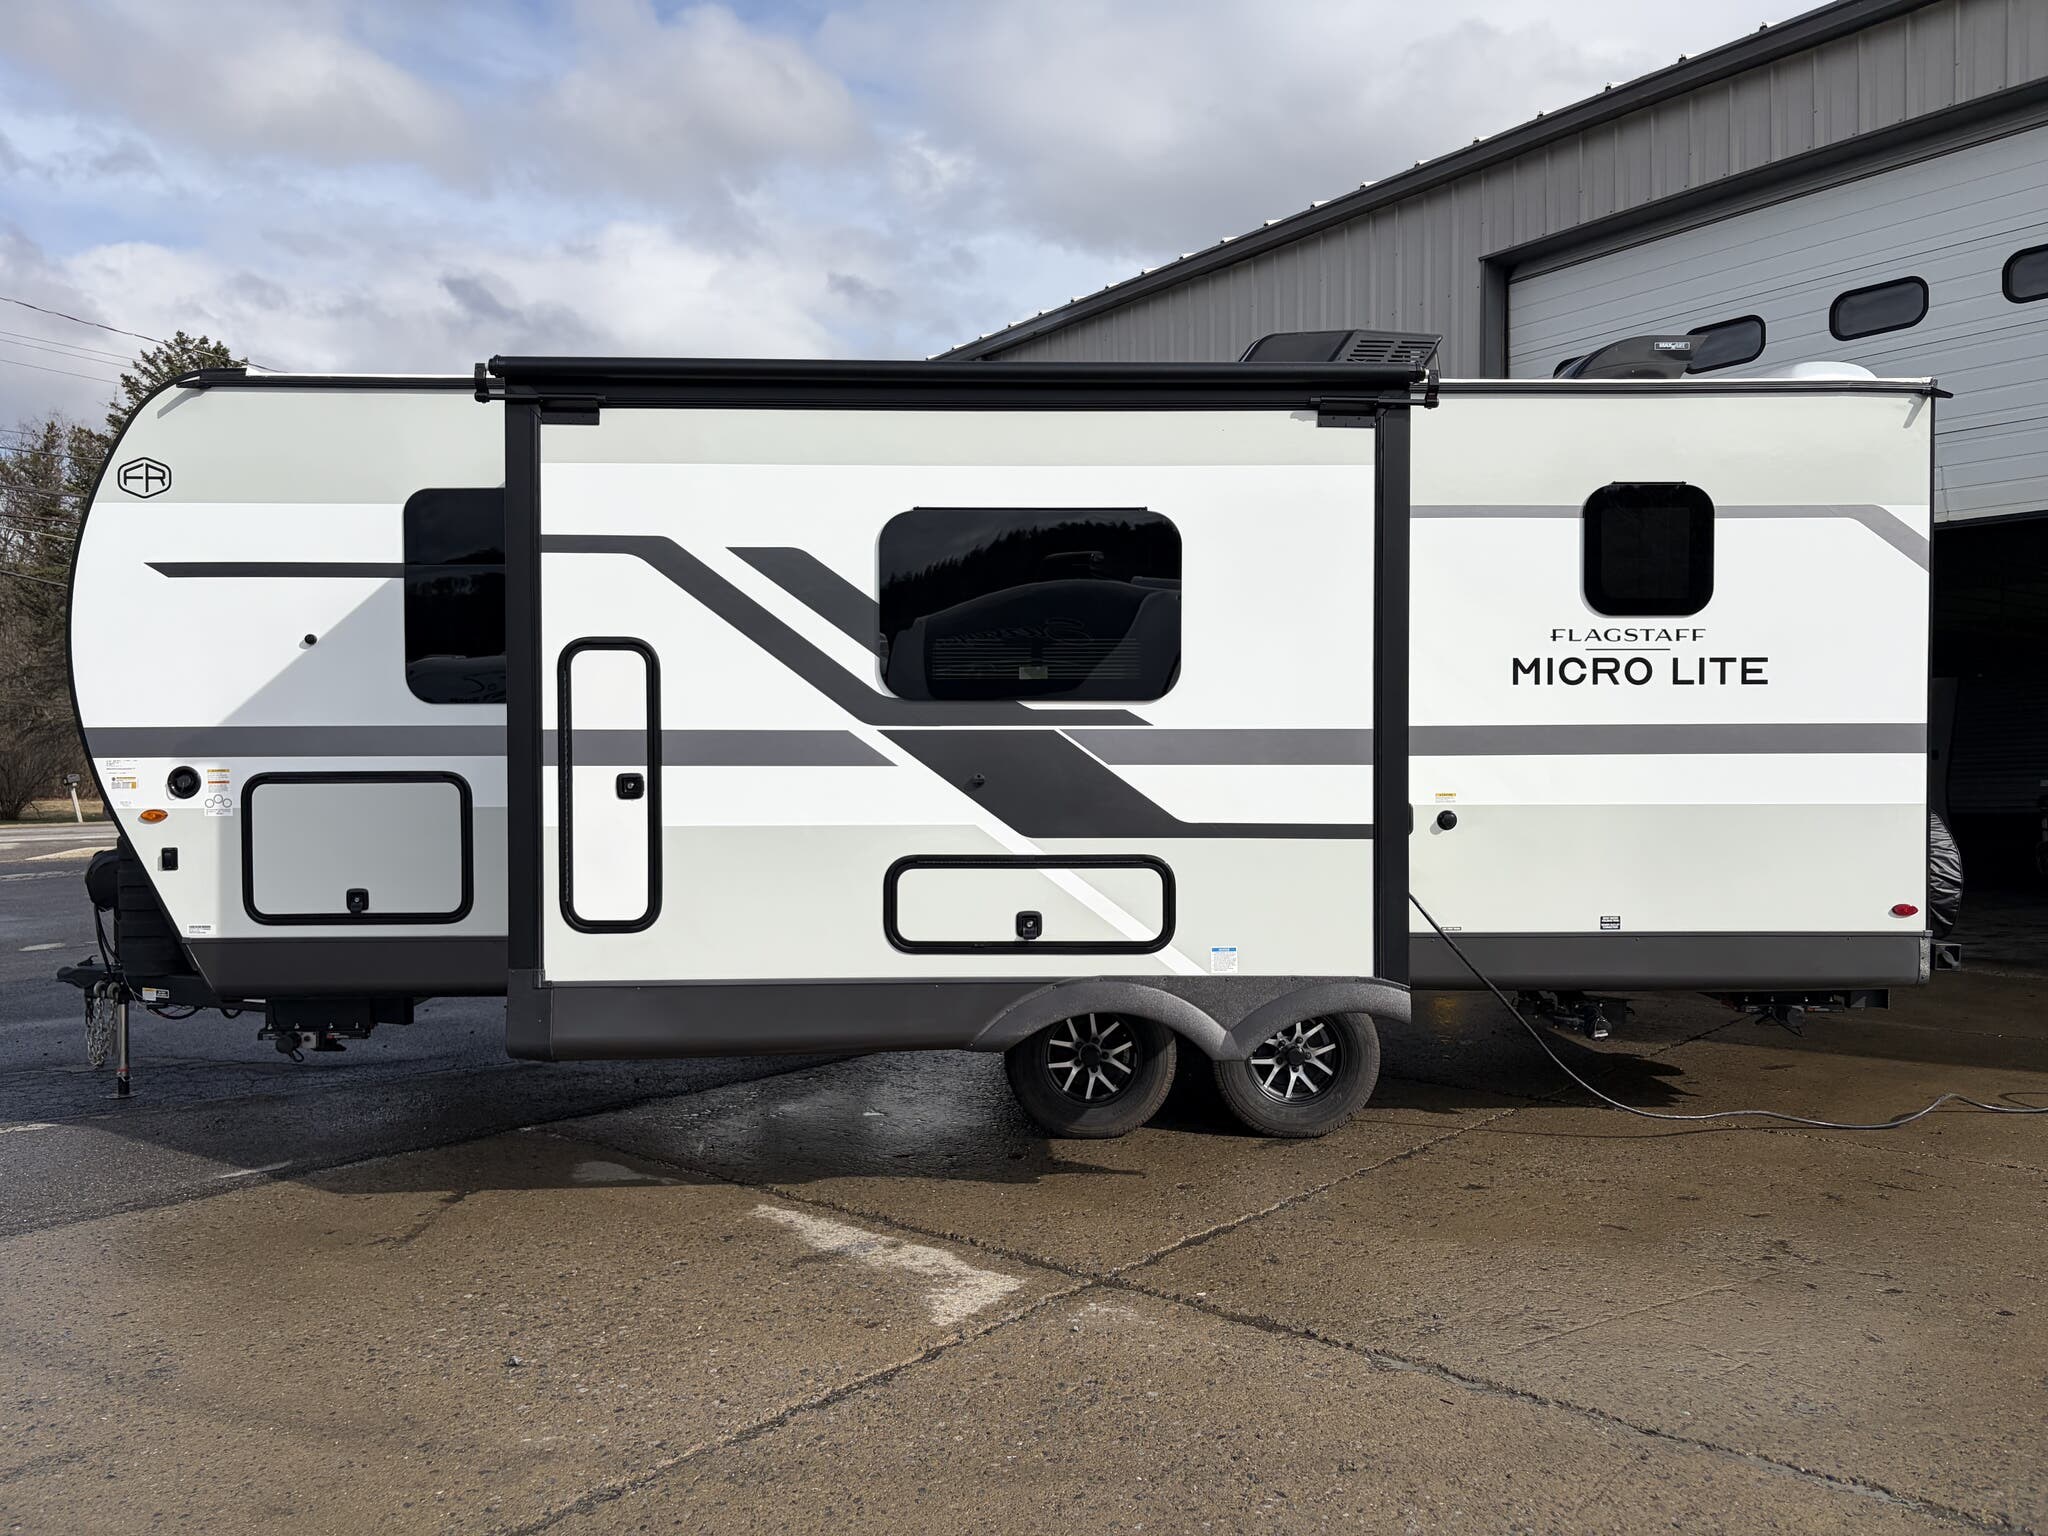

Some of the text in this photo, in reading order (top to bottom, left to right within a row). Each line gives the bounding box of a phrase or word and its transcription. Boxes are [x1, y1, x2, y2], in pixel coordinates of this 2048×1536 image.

[123, 462, 166, 493] FR
[1550, 628, 1706, 642] FLAGSTAFF
[1512, 656, 1769, 686] MICRO LITE
